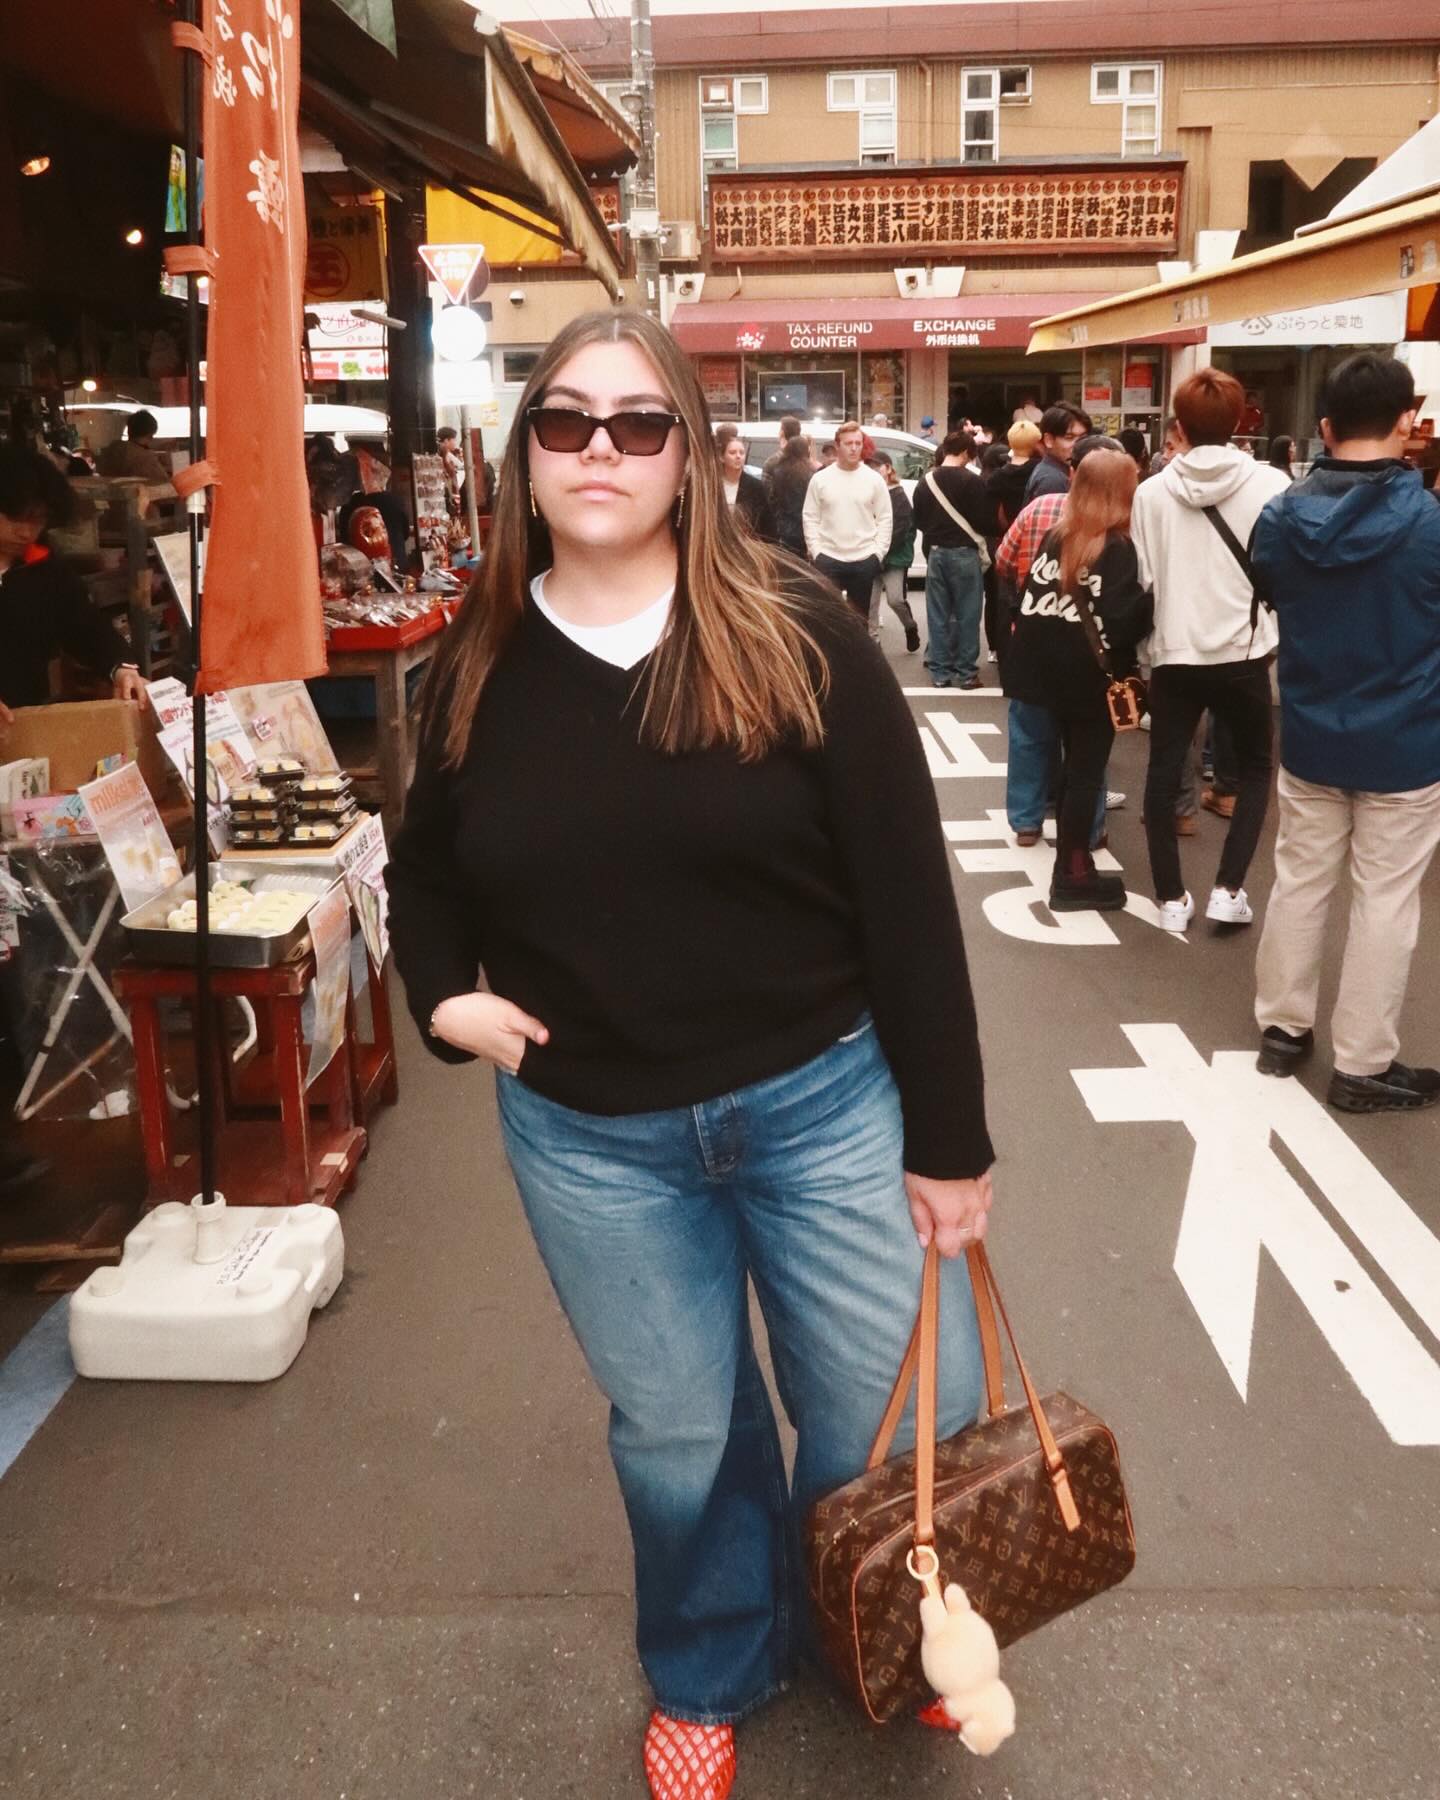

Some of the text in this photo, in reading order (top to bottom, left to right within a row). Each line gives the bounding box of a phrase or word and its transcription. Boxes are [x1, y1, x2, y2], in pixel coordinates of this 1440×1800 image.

[848, 204, 861, 243] 丸久
[787, 322, 873, 335] TAX-REFUND
[913, 319, 996, 332] EXCHANGE
[1277, 314, 1364, 330] ぷらっと築地
[790, 335, 857, 349] COUNTER
